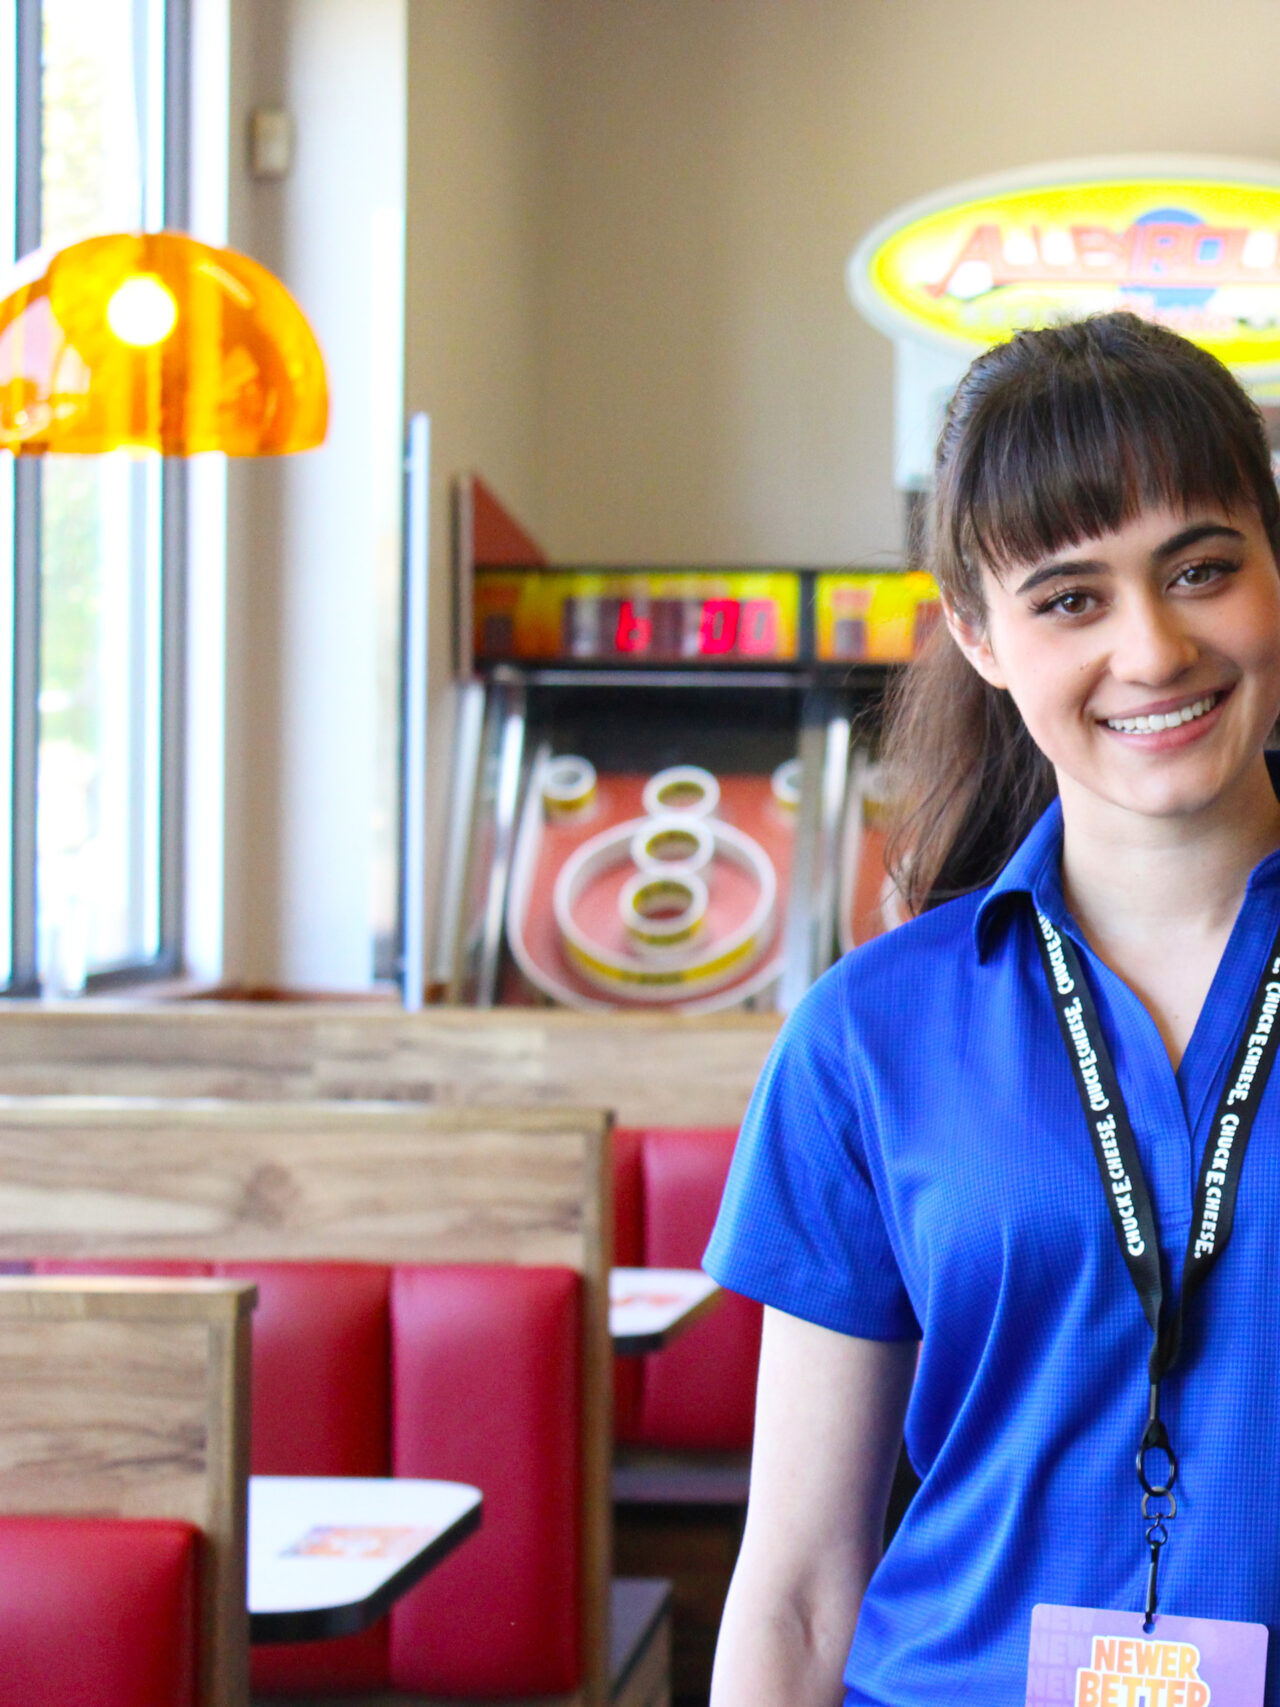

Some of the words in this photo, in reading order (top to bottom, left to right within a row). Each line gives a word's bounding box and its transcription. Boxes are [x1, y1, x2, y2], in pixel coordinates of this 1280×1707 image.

[1049, 947, 1075, 995] CHUCK
[1081, 1063, 1110, 1112] CHUCK
[1226, 1046, 1263, 1106] CHEESE.
[1095, 1113, 1125, 1180] CHEESE.
[1211, 1113, 1240, 1171] CHUCK
[1115, 1193, 1145, 1257] CHUCK
[1193, 1186, 1222, 1259] CHEESE.
[1093, 1638, 1199, 1679] NEWER
